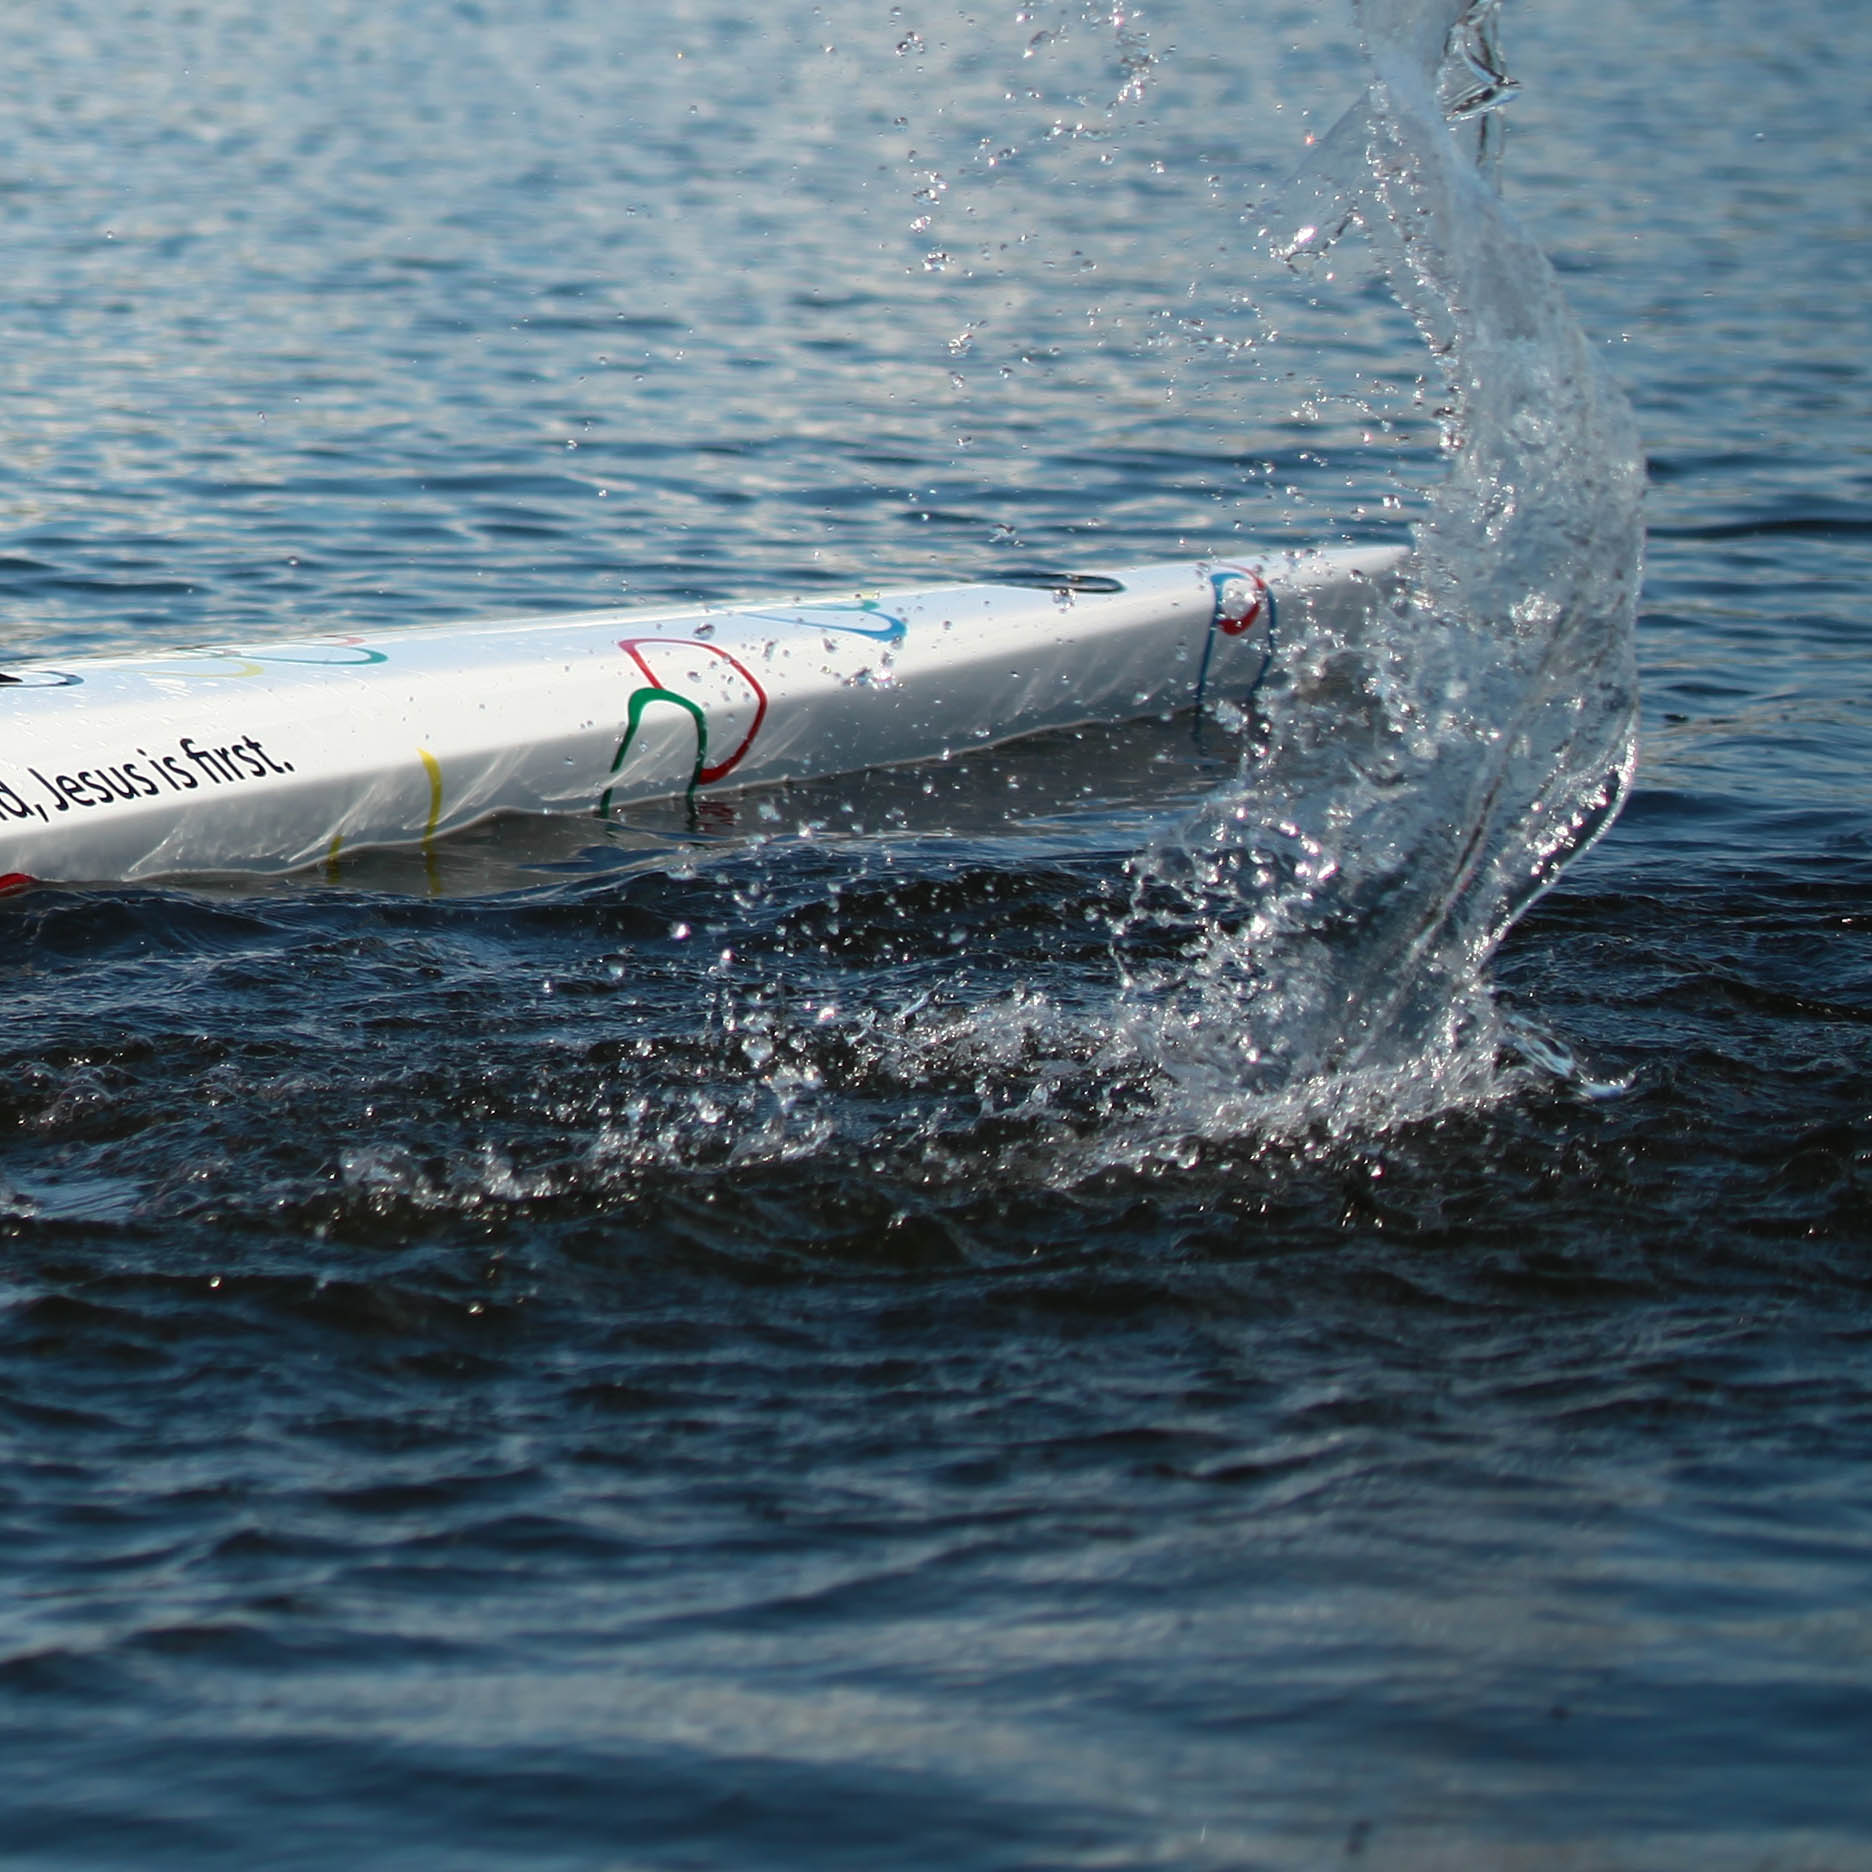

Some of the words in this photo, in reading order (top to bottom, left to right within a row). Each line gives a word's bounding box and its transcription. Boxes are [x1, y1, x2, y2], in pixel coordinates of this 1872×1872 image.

[27, 768, 160, 812] Jesus
[136, 748, 199, 791] is
[180, 735, 296, 784] first.
